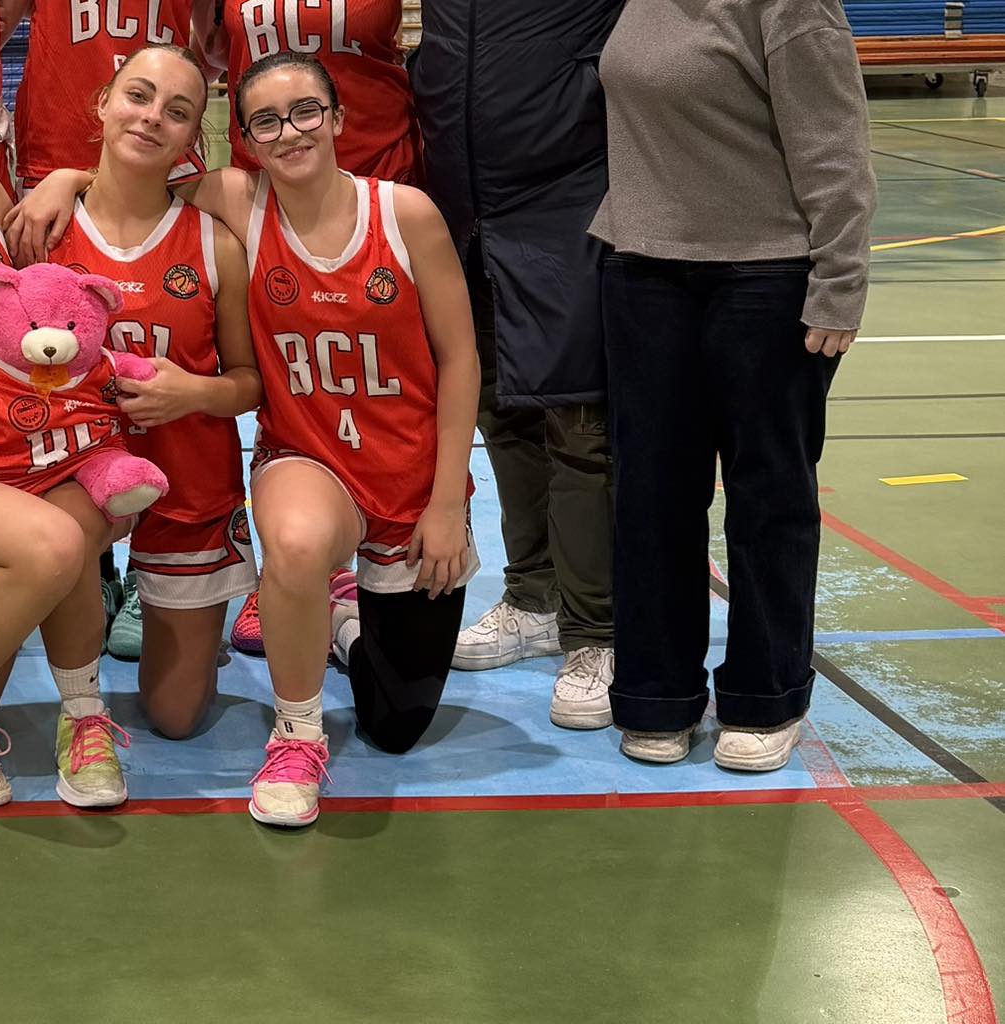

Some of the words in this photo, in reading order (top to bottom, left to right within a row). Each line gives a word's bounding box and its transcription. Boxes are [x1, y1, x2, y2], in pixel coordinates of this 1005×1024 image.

[311, 290, 348, 304] KICKZ
[272, 330, 402, 397] BCL
[337, 407, 362, 450] 4
